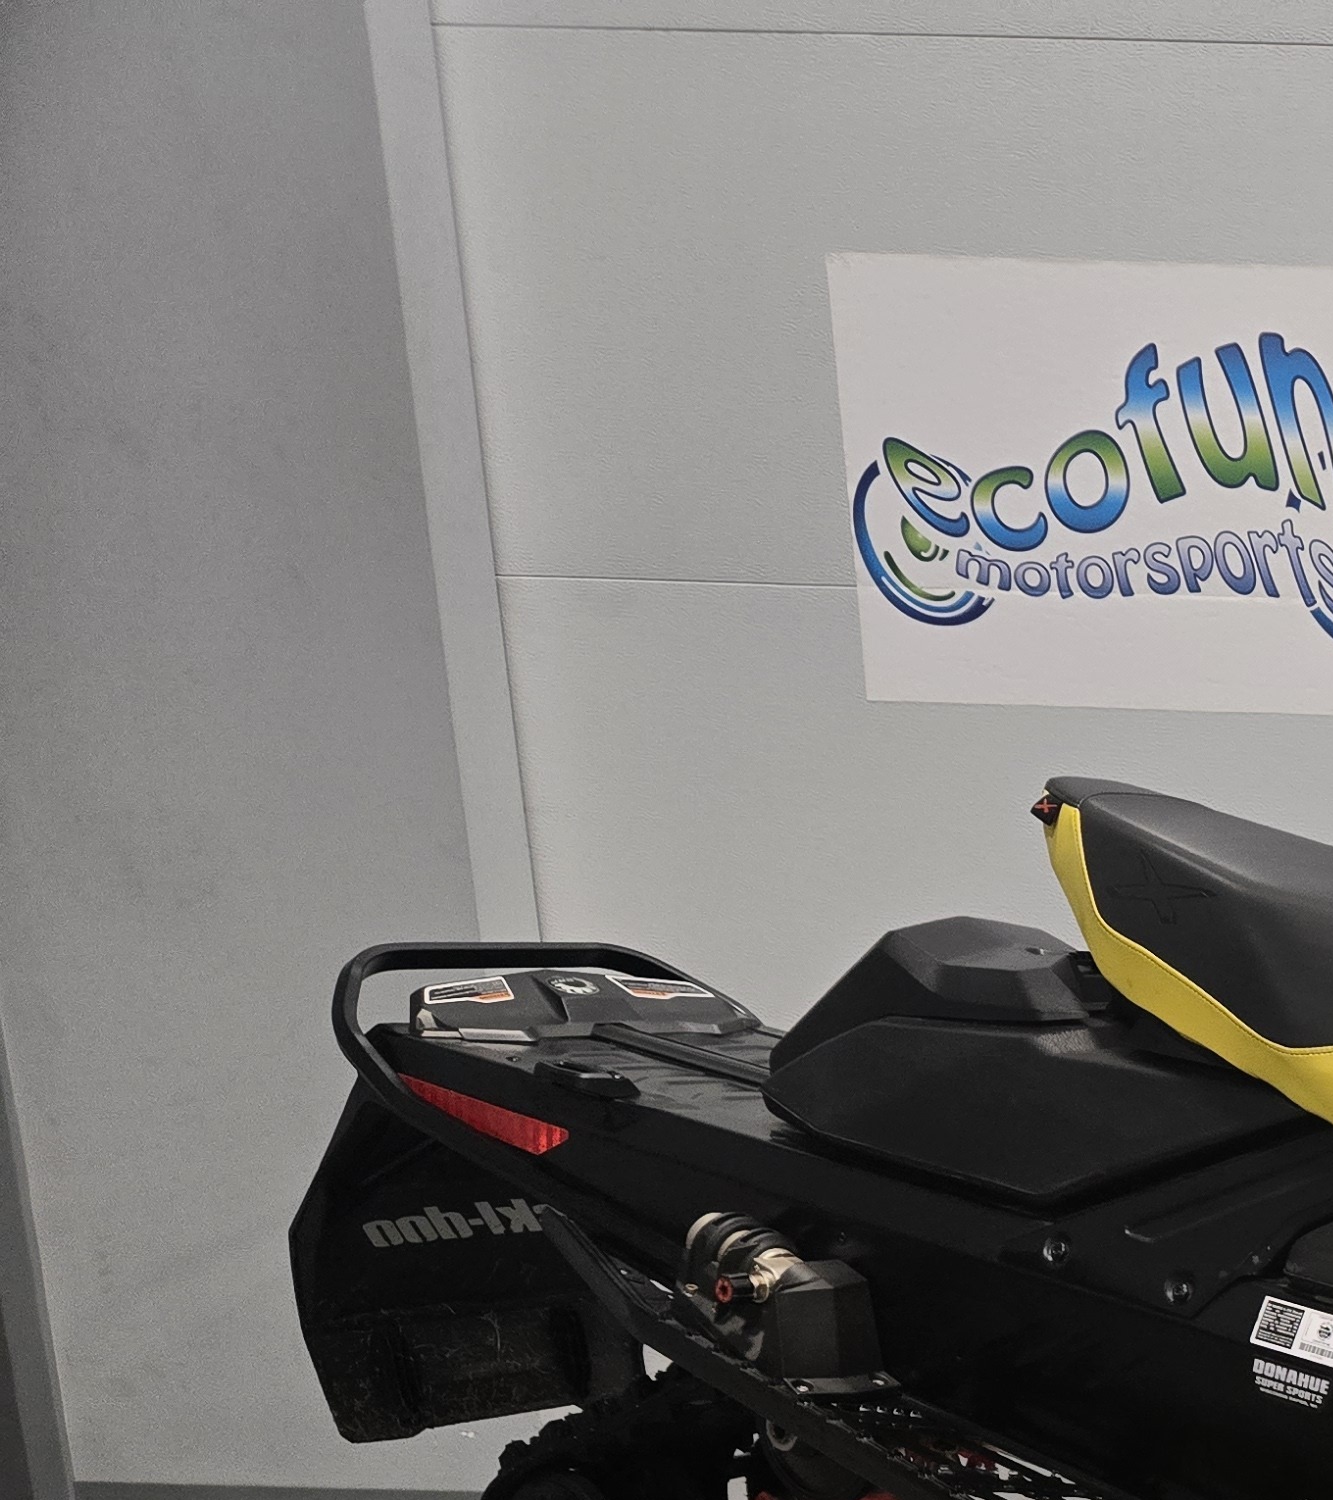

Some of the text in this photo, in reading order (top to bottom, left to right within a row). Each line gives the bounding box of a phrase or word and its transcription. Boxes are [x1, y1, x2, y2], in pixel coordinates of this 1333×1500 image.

[1253, 1358, 1330, 1395] DONAHUE
[1255, 1376, 1284, 1392] SUPER
[1286, 1386, 1323, 1404] SPORTS
